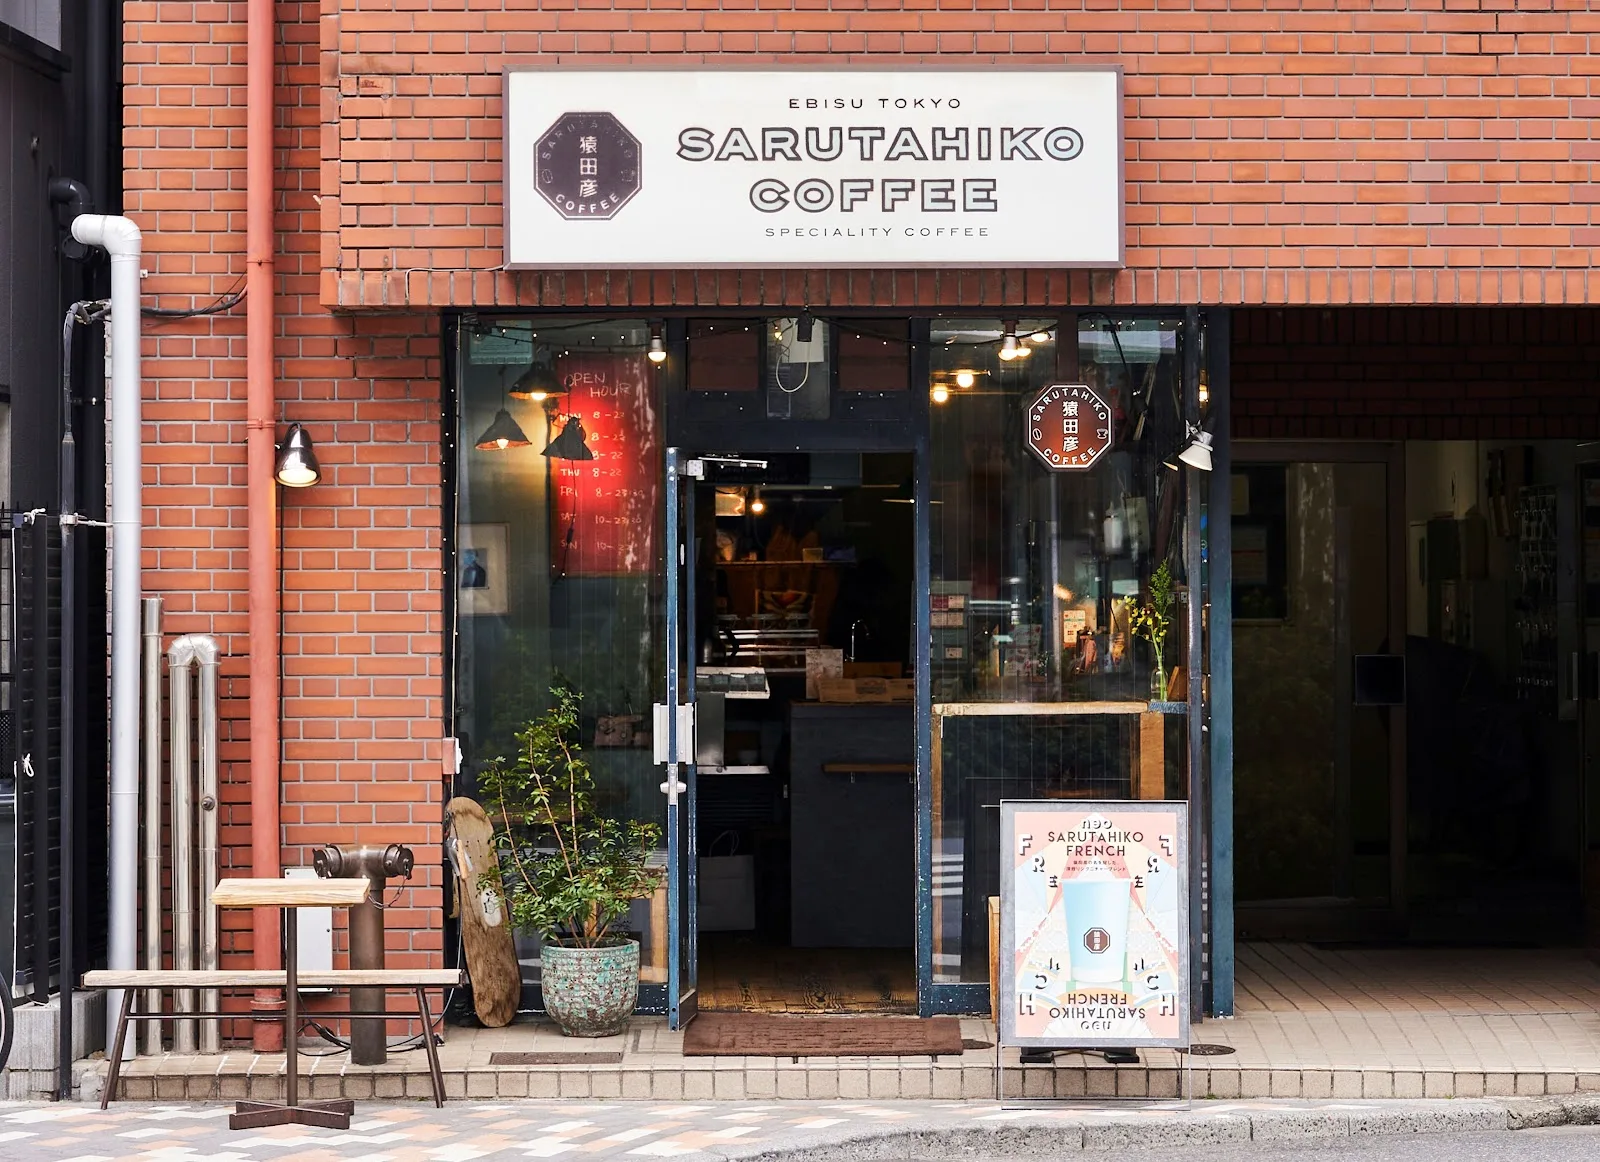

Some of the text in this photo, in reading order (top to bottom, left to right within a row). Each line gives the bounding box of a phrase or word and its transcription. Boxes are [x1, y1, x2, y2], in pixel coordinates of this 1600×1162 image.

[788, 98, 962, 109] EBISU TOKYO
[676, 126, 1084, 162] SARUTAHIKO
[579, 135, 598, 198] 猿田彦
[748, 177, 999, 214] COFFEE
[555, 192, 620, 214] COFFEE
[764, 227, 989, 237] SPECIALITY COFFEE
[564, 371, 606, 388] OPEN
[590, 382, 631, 398] HOUR
[1032, 387, 1108, 422] SARUTAHIKO
[1062, 400, 1079, 453] 猿田彦
[1043, 448, 1097, 465] COFFEE
[560, 468, 580, 477] THU
[560, 486, 578, 498] FRI
[560, 540, 578, 550] SN
[1048, 831, 1144, 843] SARUTAHIKO
[1066, 845, 1126, 857] FRENCH
[1068, 993, 1127, 1005] FRENCH
[1049, 1007, 1146, 1019] SARUTAHIKO
